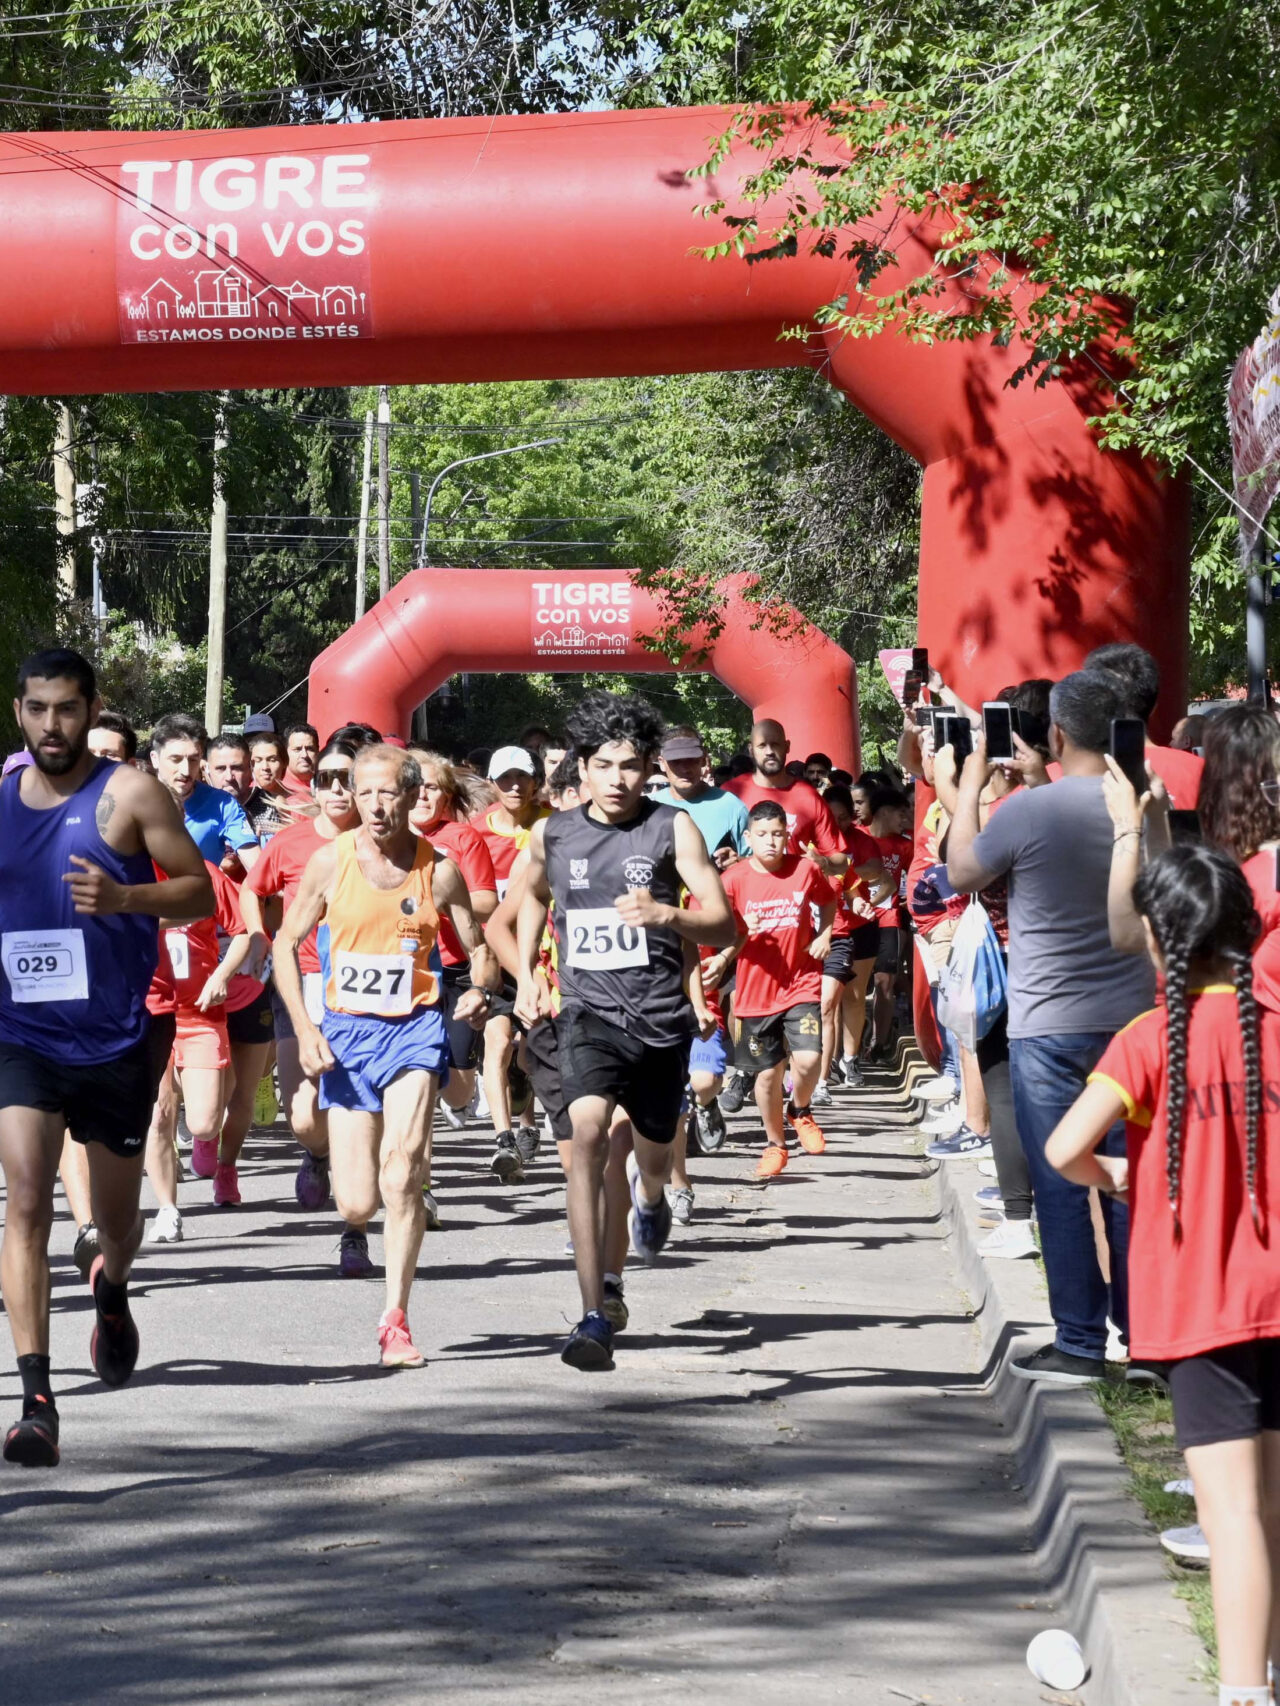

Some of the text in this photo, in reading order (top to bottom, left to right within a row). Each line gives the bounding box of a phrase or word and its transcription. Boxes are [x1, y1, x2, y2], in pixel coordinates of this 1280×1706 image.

[121, 154, 371, 212] TIGRE
[137, 322, 360, 343] ESTAMOS DONDE ESTÉS
[531, 582, 632, 606] TIGRE
[537, 646, 626, 656] ESTAMOS DONDE ESTÉS
[573, 922, 640, 954] 250
[17, 955, 58, 974] 029
[340, 965, 406, 996] 227
[959, 1137, 982, 1152] FILA
